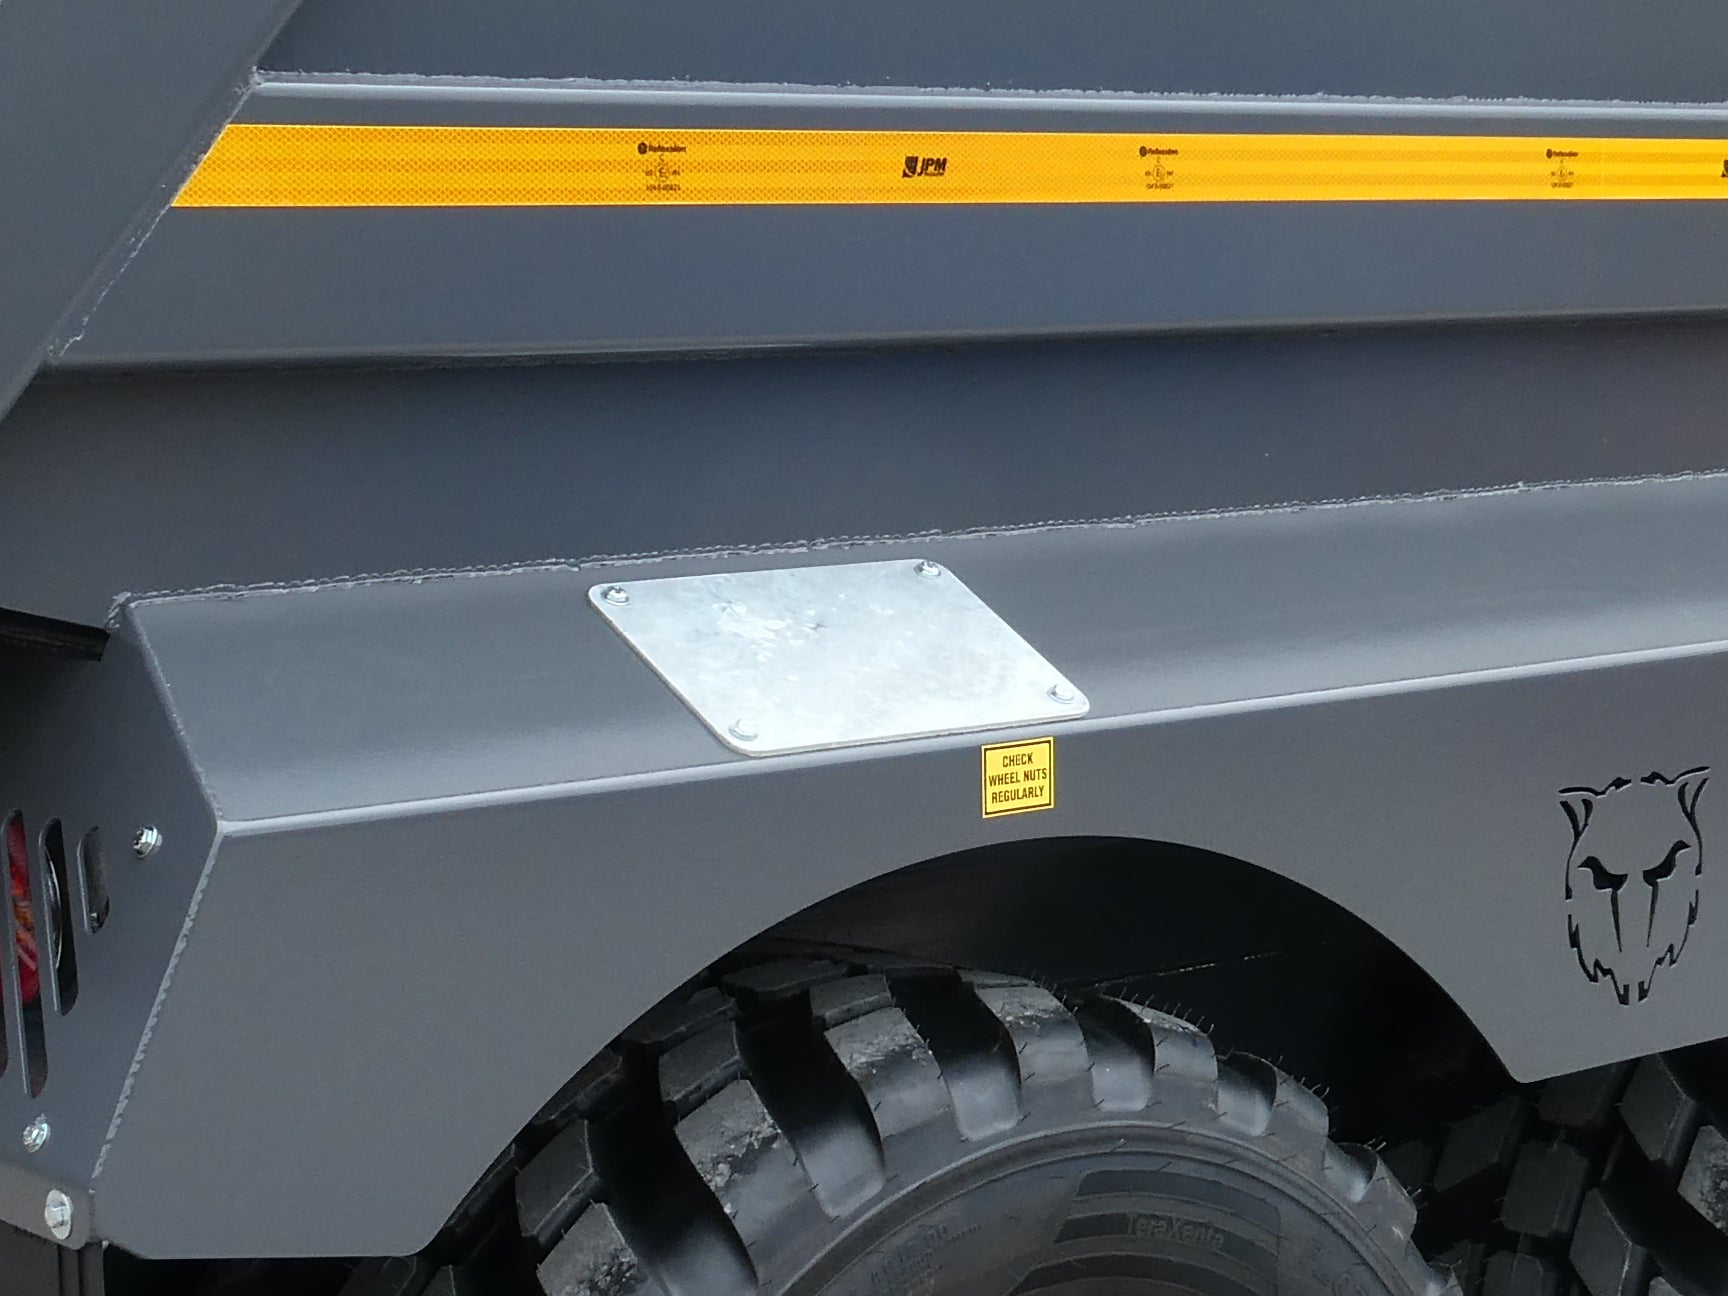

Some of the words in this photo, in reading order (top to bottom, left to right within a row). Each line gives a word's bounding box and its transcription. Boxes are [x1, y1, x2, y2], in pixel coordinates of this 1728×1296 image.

[1002, 752, 1033, 768] CHECK
[988, 771, 1021, 787] WHEEL
[1023, 768, 1047, 782] NUTS
[992, 785, 1045, 804] REGULARLY
